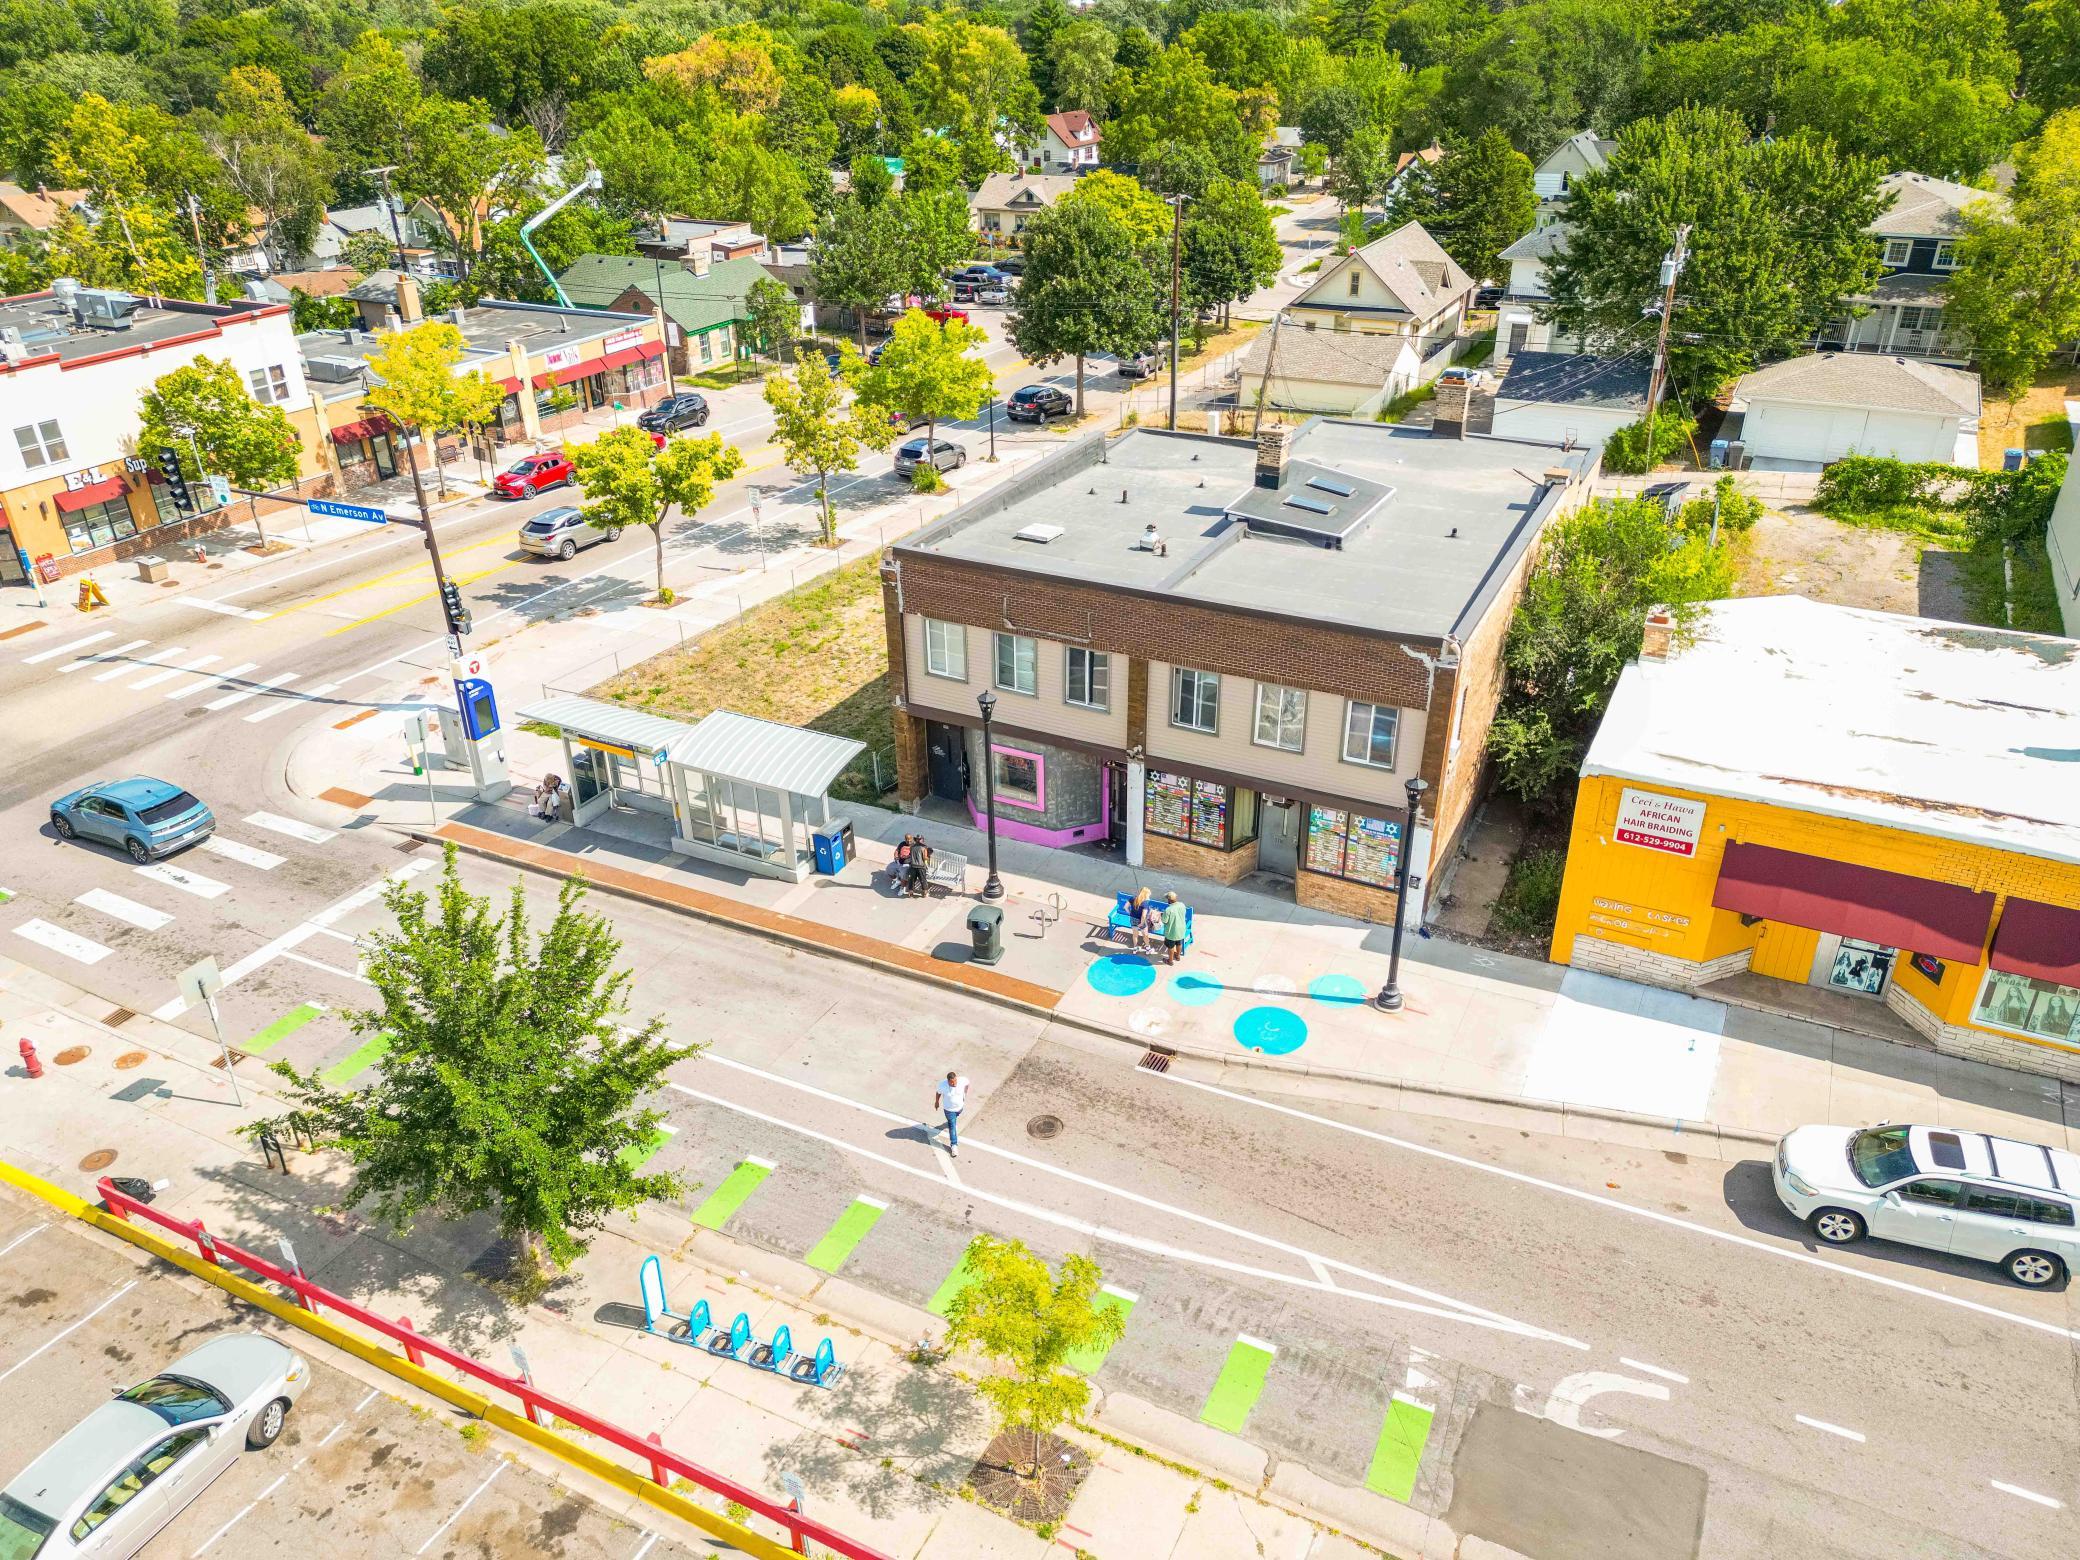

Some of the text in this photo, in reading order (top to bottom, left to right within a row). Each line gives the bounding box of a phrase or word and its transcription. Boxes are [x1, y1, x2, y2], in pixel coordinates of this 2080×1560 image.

[65, 468, 108, 492] E&L
[320, 503, 384, 521] N Emerson Av
[1631, 795, 1652, 807] Ceci
[1663, 801, 1695, 815] Hawa
[1639, 809, 1681, 823] AFRICAN
[1623, 816, 1693, 838] HAIR BRAIDING
[1623, 832, 1686, 851] 612-529-9904
